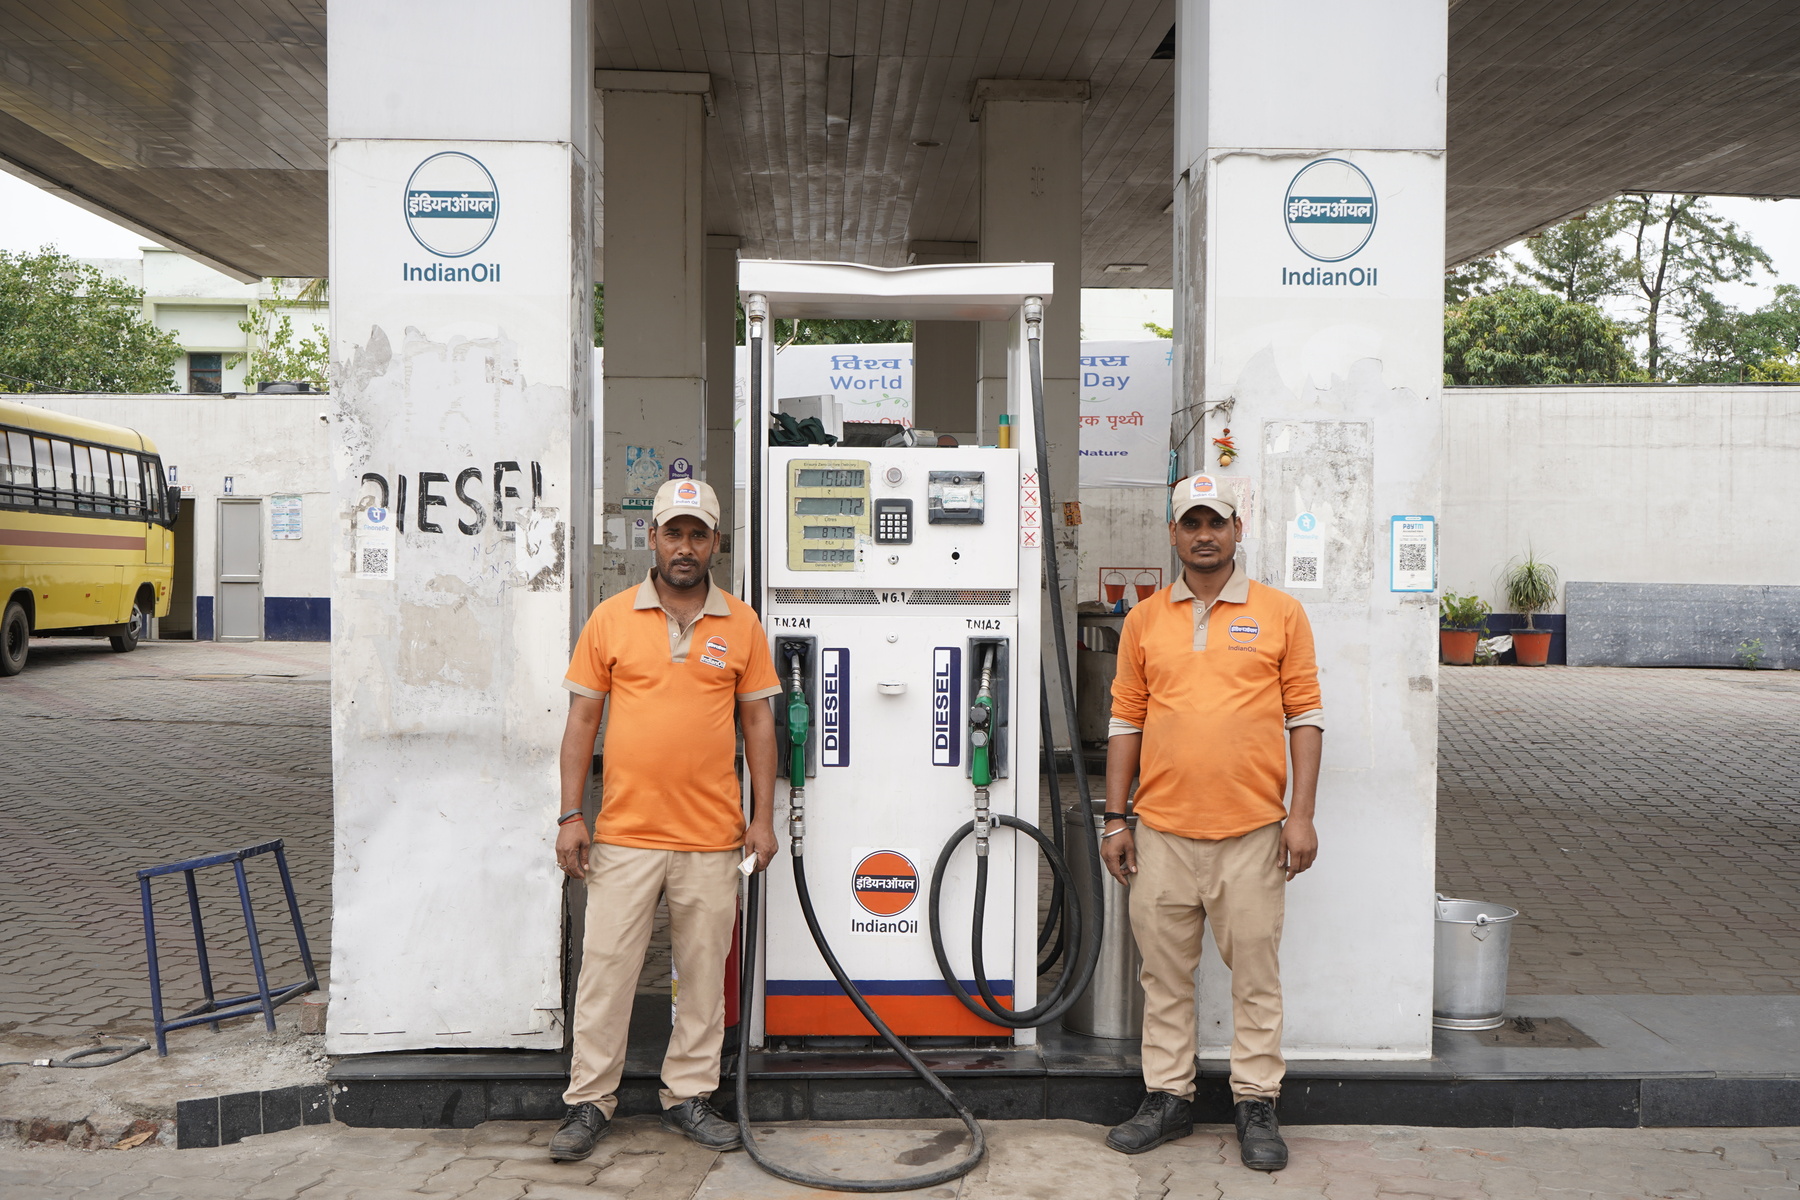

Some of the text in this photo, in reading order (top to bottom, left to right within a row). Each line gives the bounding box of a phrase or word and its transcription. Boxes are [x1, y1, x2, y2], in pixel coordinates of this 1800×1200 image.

[409, 193, 494, 216] इंडियनऑयल
[1289, 199, 1372, 221] इंडियनऑयल
[403, 263, 500, 282] IndianOil
[1282, 267, 1377, 286] IndianOil
[831, 355, 902, 370] विश्व
[830, 373, 1130, 390] World Day
[1106, 411, 1144, 430] पृथ्वी
[825, 664, 838, 750] DIESEL
[936, 663, 949, 750] DIESEL
[856, 876, 915, 890] इंडियनऑयल
[851, 919, 918, 933] IndianOil
